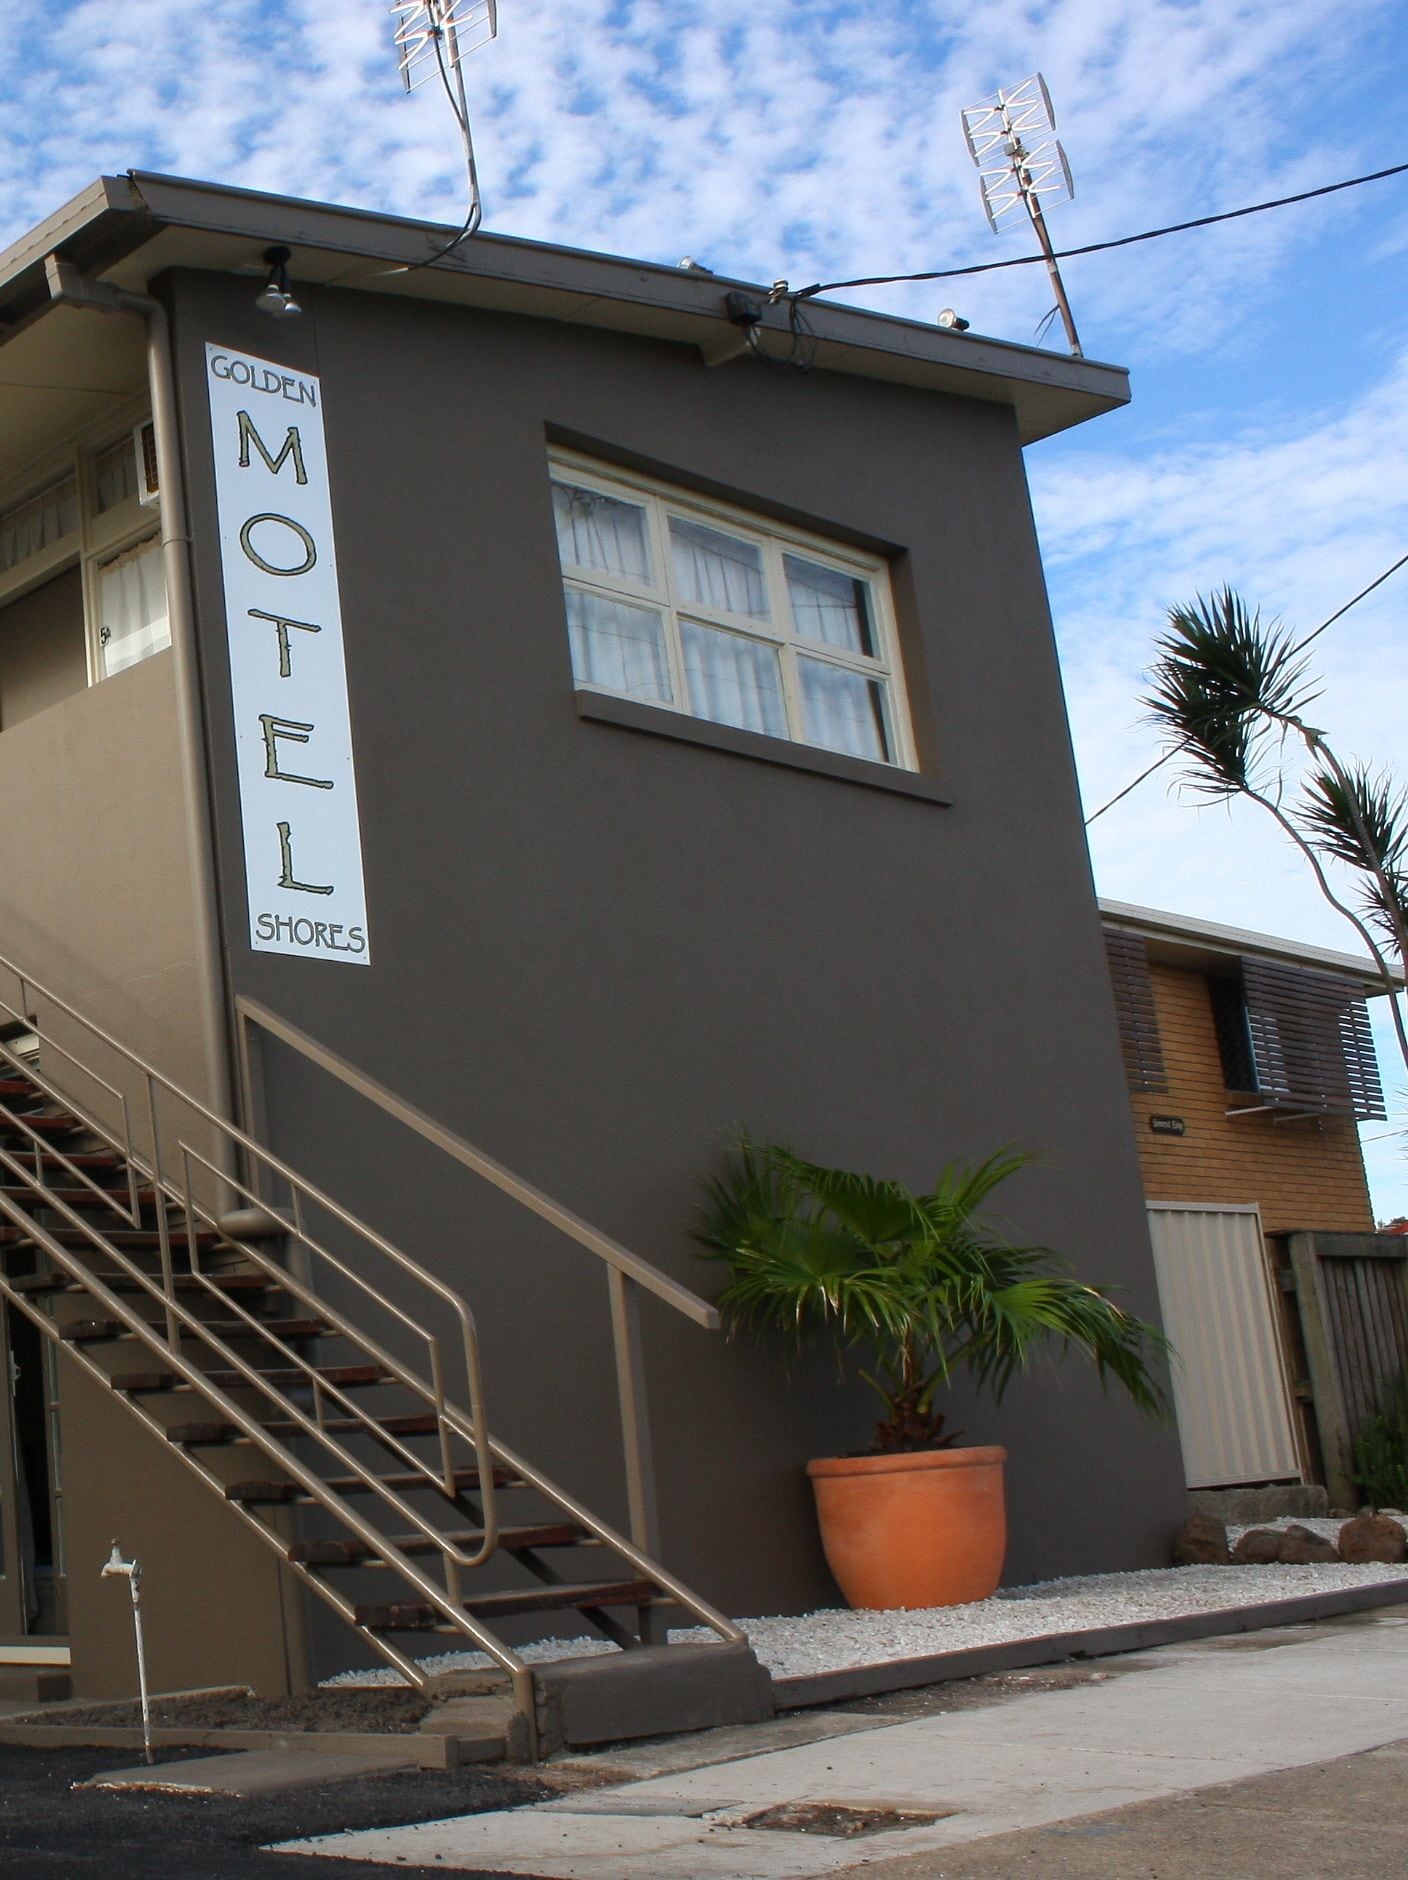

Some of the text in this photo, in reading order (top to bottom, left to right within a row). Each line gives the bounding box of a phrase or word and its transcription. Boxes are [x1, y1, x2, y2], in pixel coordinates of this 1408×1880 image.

[210, 355, 317, 408] GOLDEN
[236, 410, 335, 895] MOTEL
[255, 913, 367, 953] SHORES
